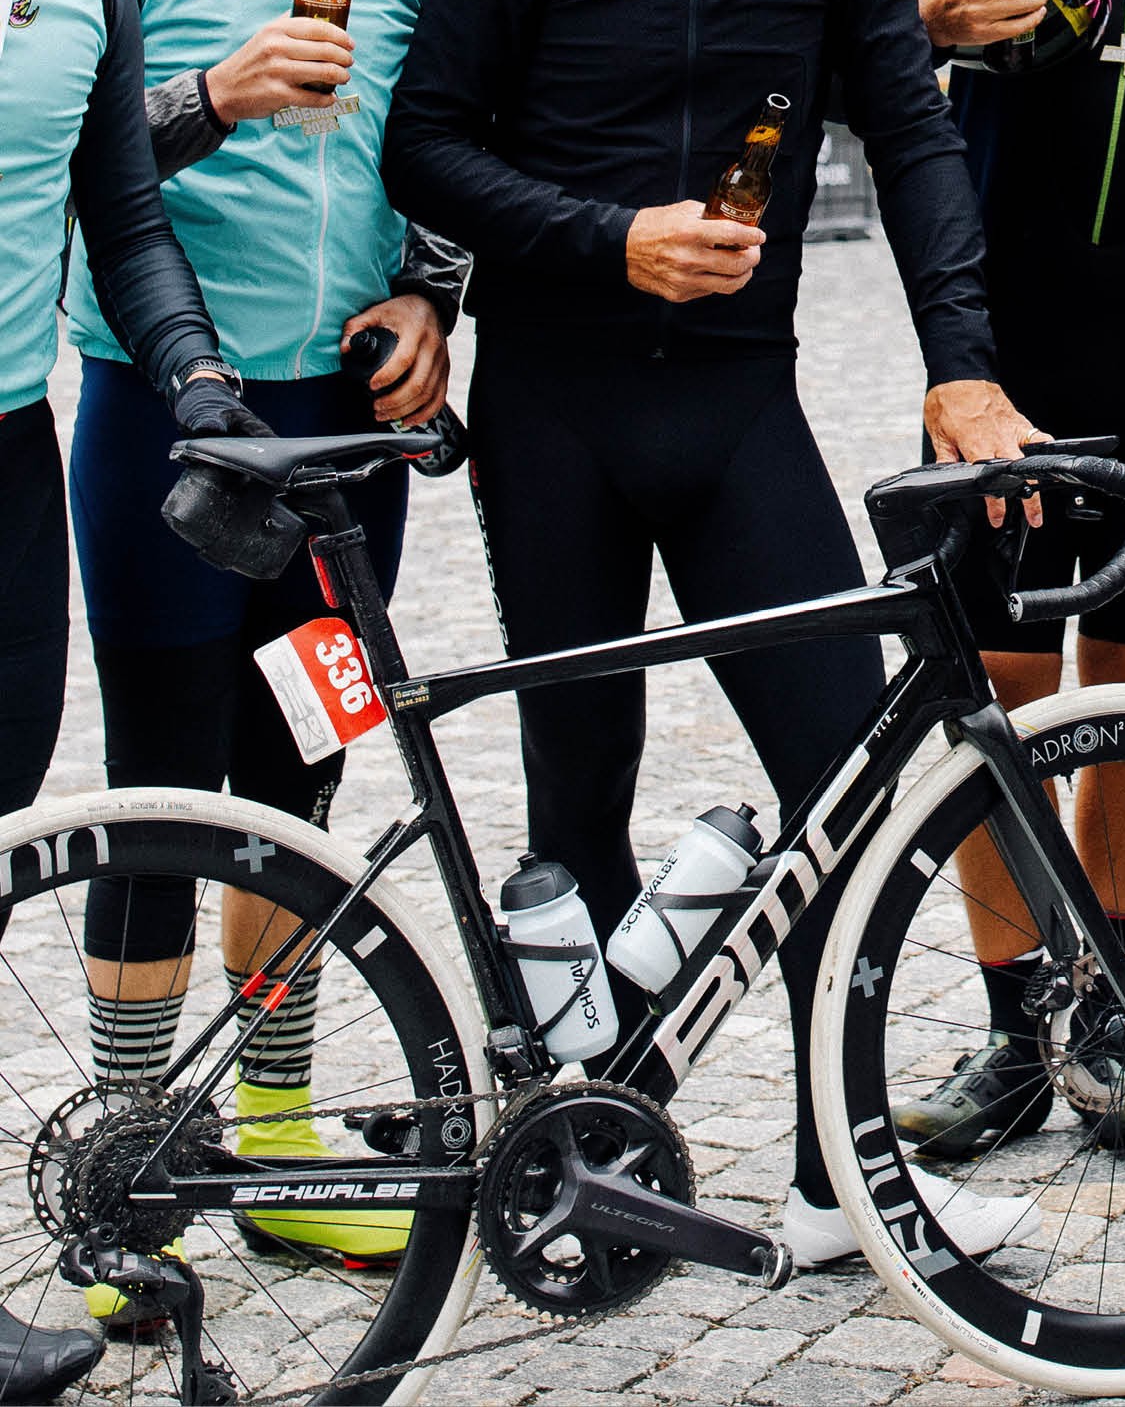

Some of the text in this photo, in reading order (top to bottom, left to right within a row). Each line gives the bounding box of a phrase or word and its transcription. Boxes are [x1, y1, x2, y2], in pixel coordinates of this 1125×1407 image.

[315, 633, 373, 715] 336
[620, 855, 677, 934] SCHWALBE
[653, 744, 887, 1094] BMC
[231, 1182, 421, 1206] SCHWALBE
[591, 1202, 676, 1233] ULTEGRA
